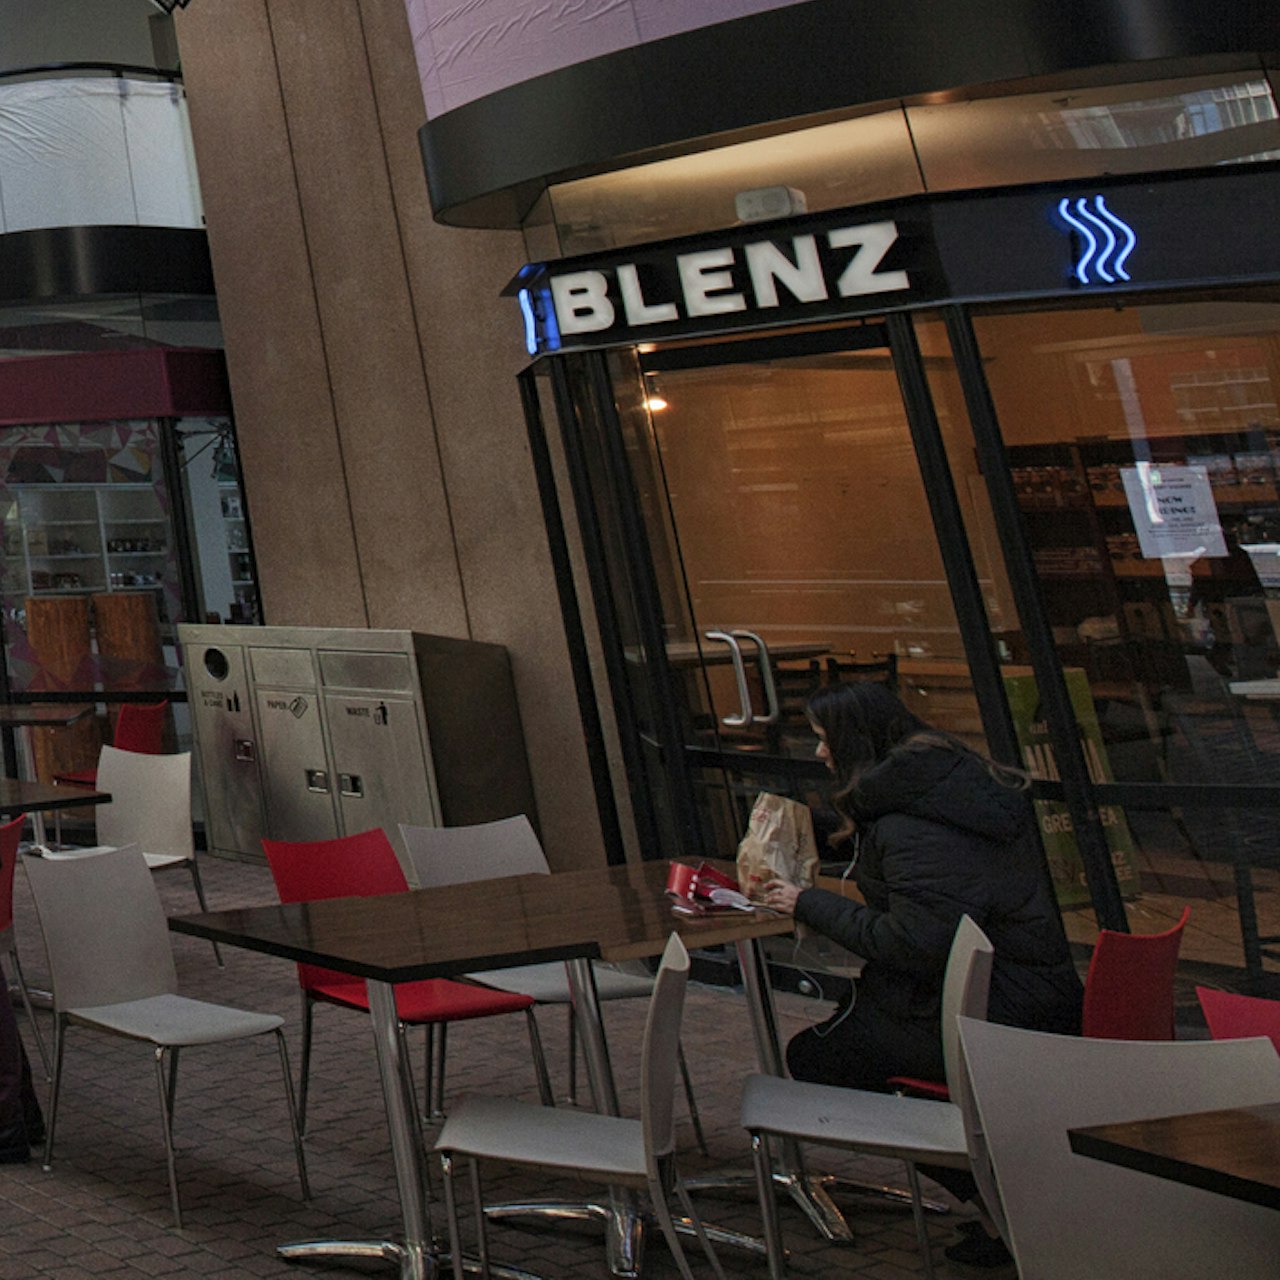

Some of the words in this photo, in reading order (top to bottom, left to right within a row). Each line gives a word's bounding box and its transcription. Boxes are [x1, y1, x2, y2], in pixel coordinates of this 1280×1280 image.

[550, 220, 910, 336] BLENZ
[267, 700, 287, 710] PAPER
[346, 707, 370, 717] WASTE
